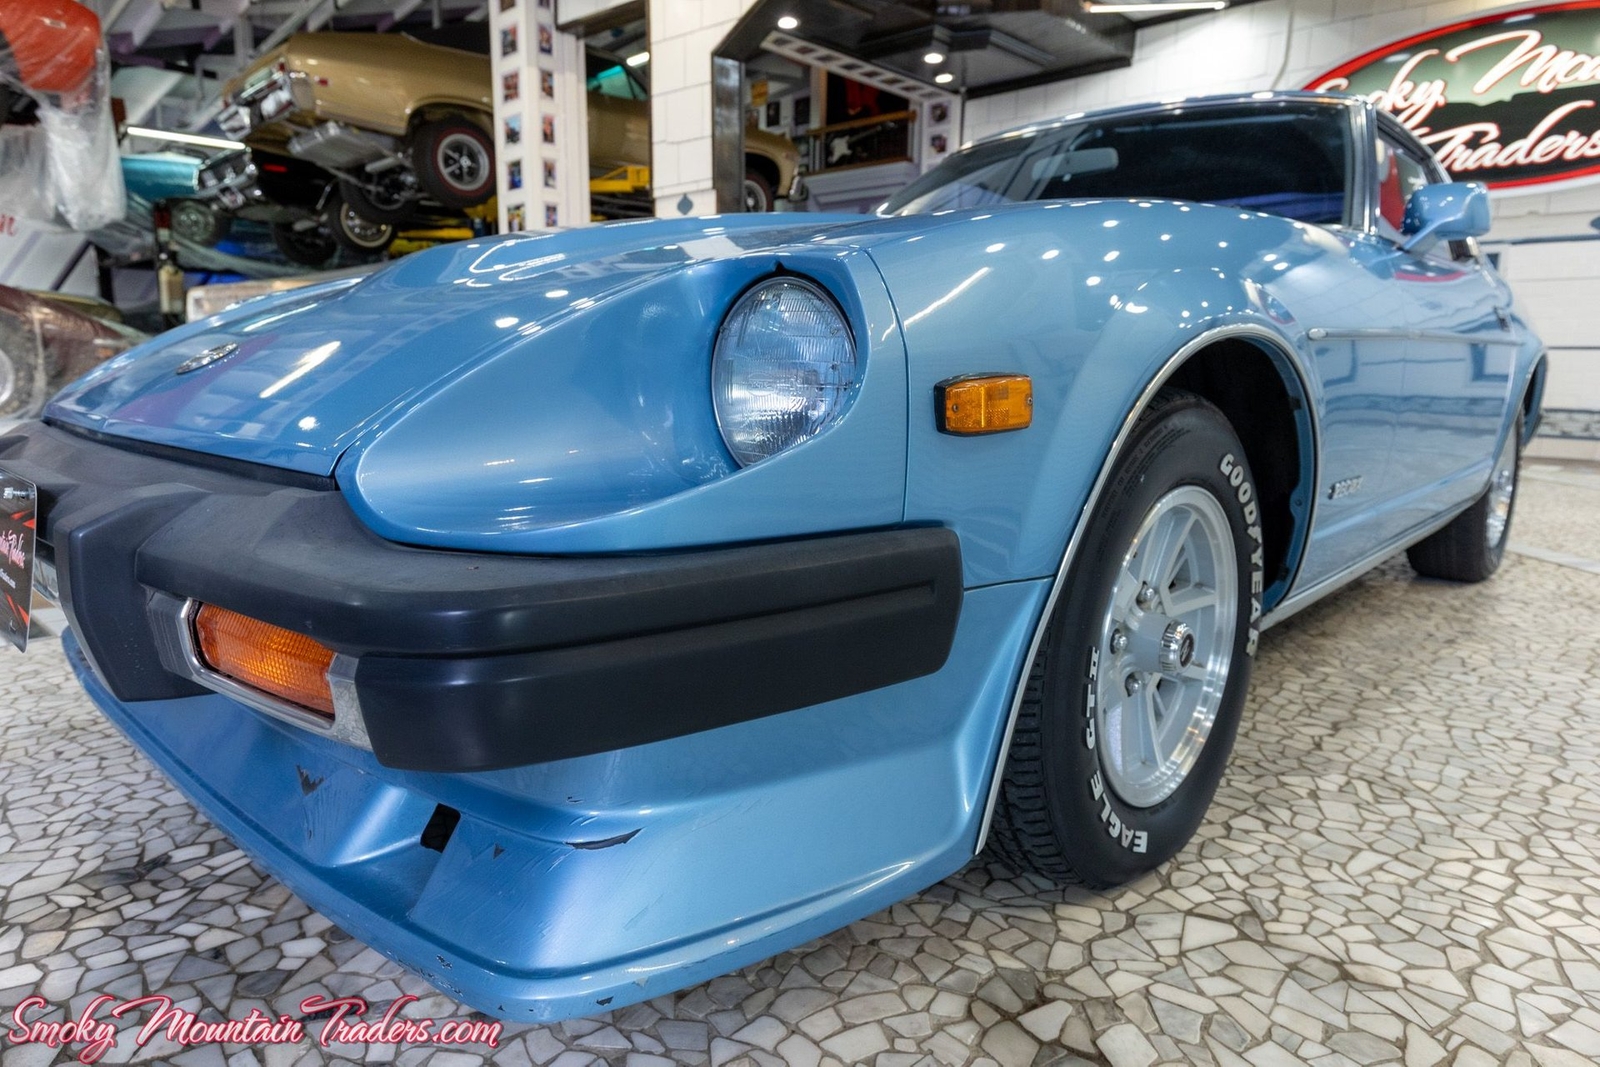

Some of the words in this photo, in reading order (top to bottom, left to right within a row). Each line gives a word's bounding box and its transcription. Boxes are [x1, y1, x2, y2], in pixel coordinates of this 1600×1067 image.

[1219, 453, 1263, 657] GOODYEAR
[1085, 683, 1096, 750] GT
[1090, 769, 1148, 854] EAGLE
